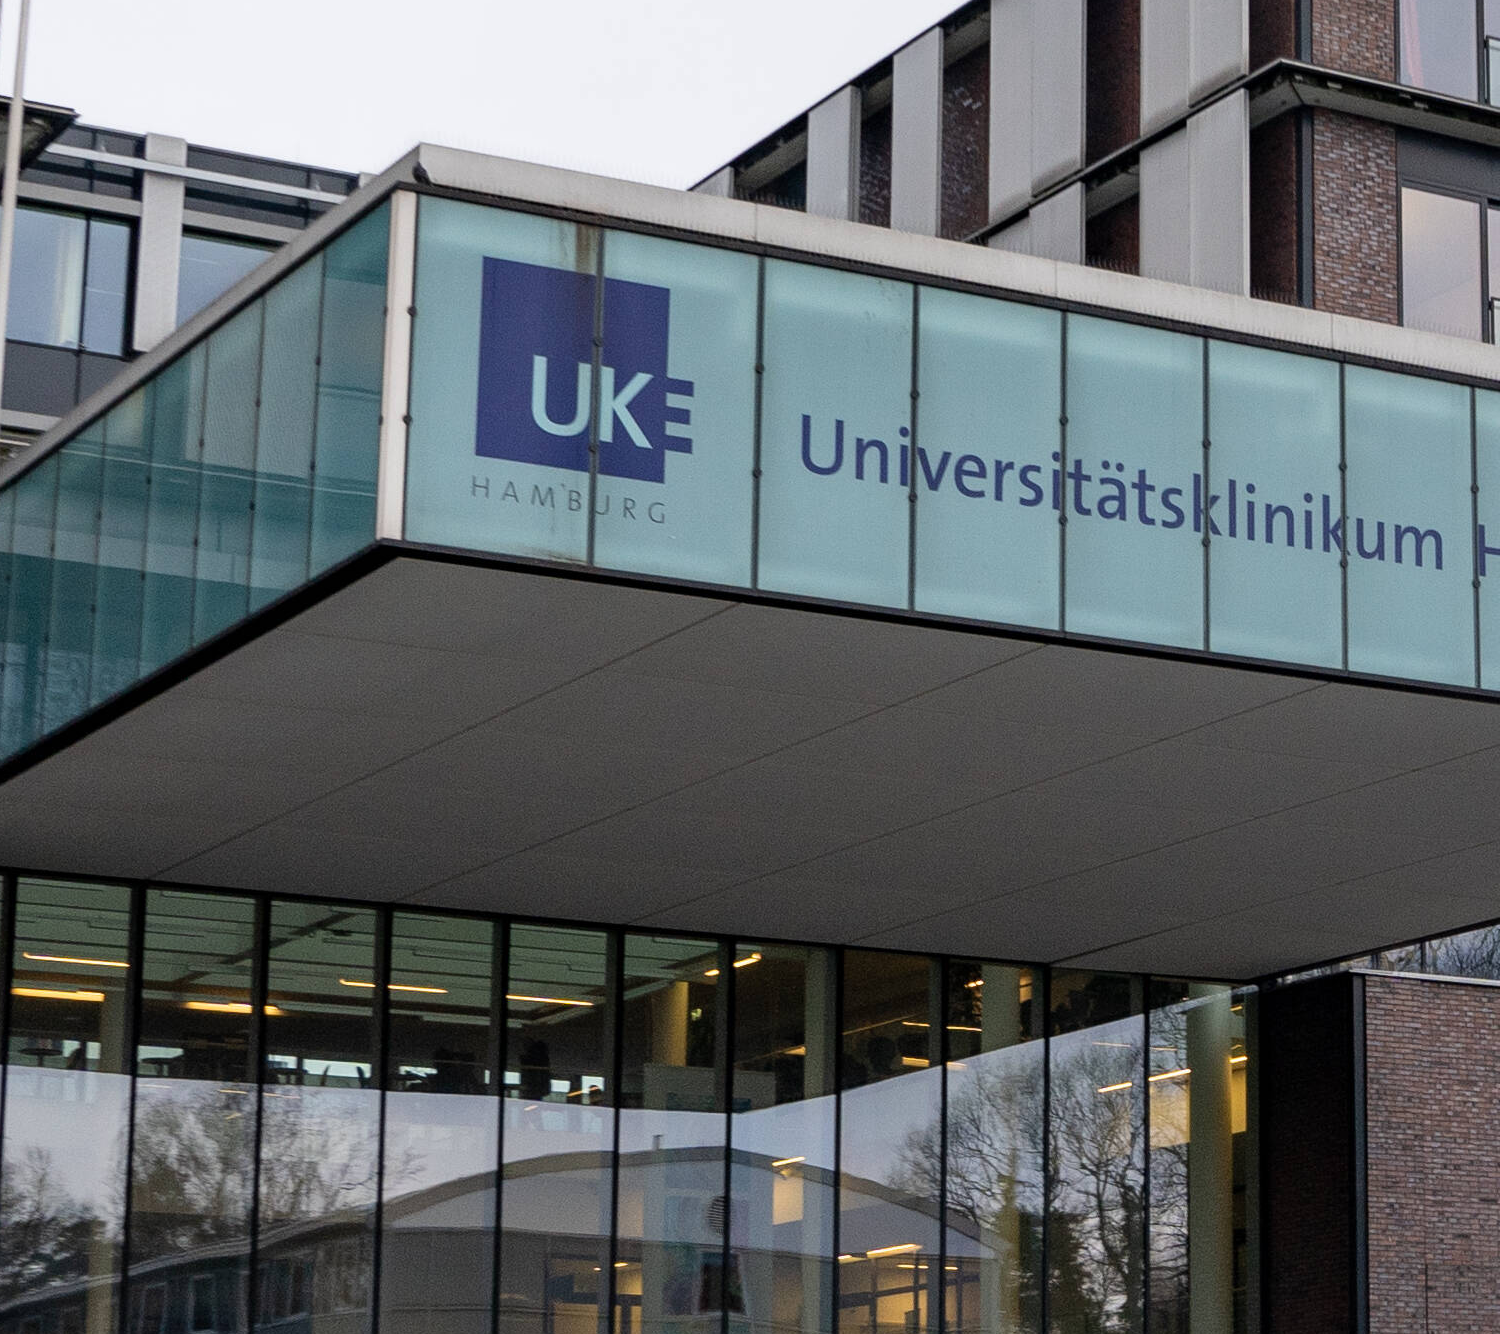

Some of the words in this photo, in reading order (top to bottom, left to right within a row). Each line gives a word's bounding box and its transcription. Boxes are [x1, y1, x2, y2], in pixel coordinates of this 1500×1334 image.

[531, 354, 694, 455] UKE
[470, 474, 668, 525] HAMBURG
[800, 413, 1445, 571] Universitätsklinikum
